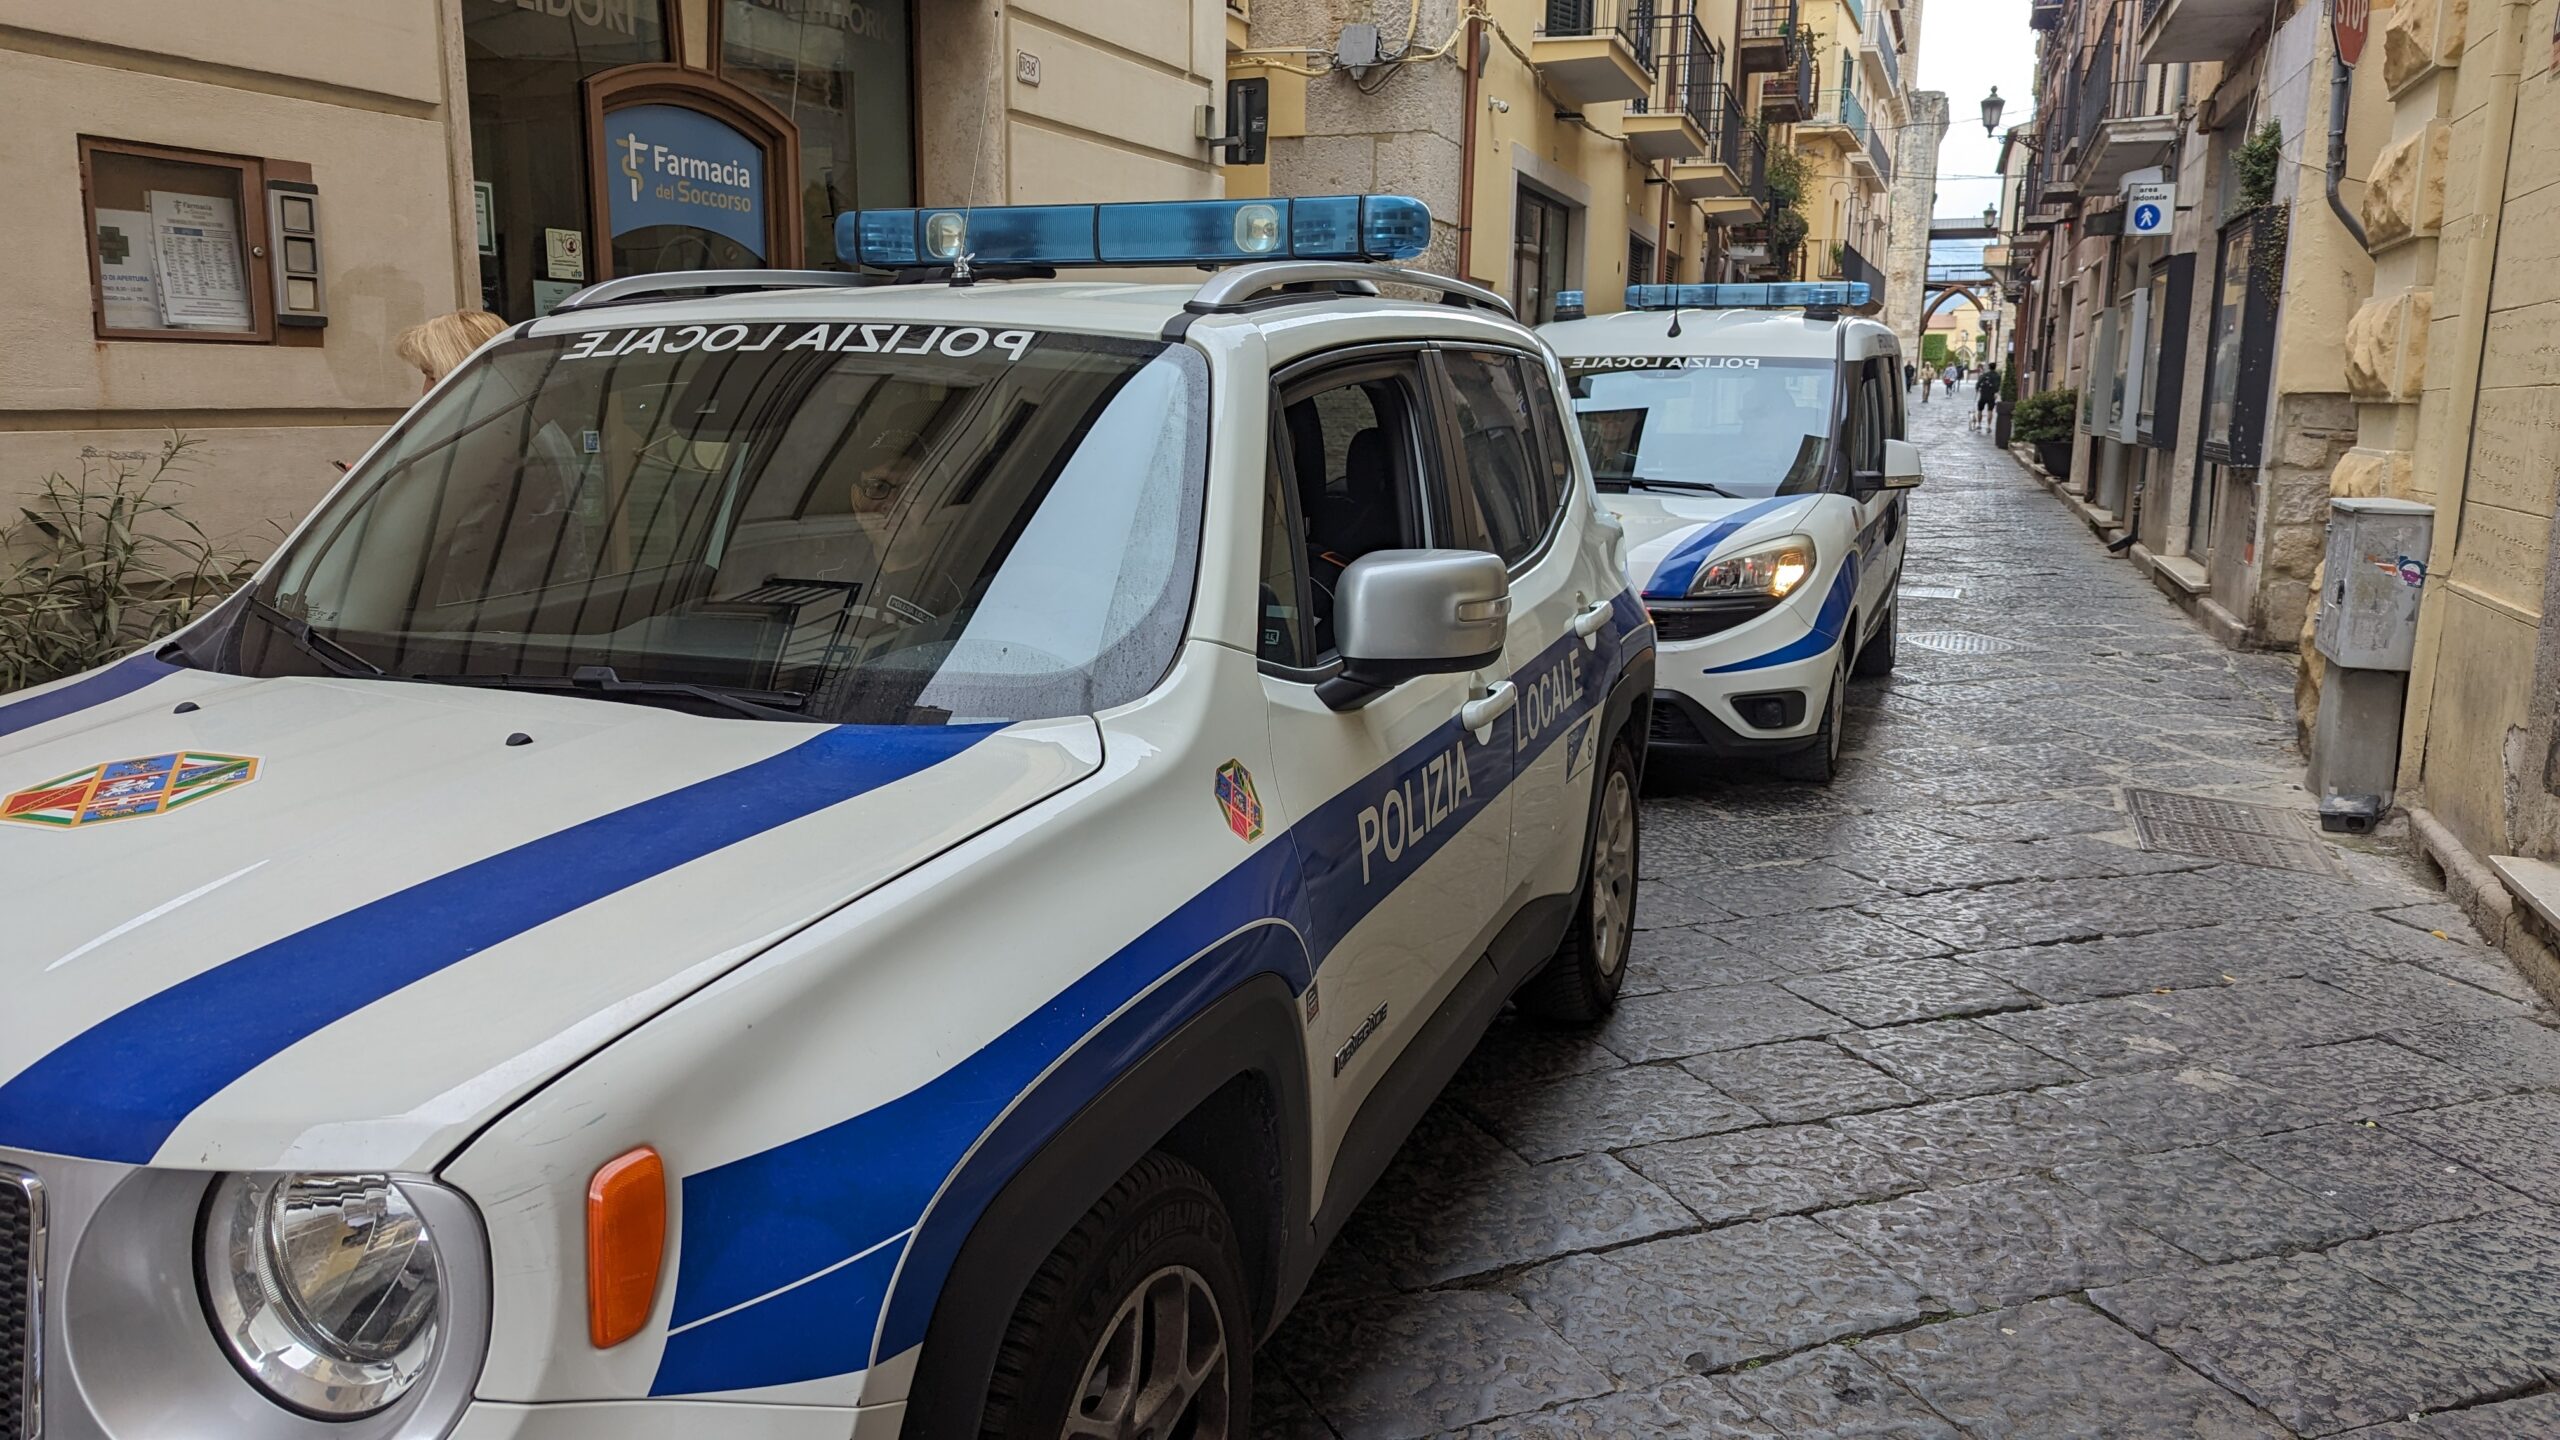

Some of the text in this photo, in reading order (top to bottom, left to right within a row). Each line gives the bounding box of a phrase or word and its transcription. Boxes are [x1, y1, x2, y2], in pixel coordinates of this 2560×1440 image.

[653, 145, 750, 189] Farmacia
[656, 180, 752, 213] del Soccorso
[1356, 647, 1584, 886] POLIZIA LOCALE
[1334, 1000, 1389, 1078] RENEGADE
